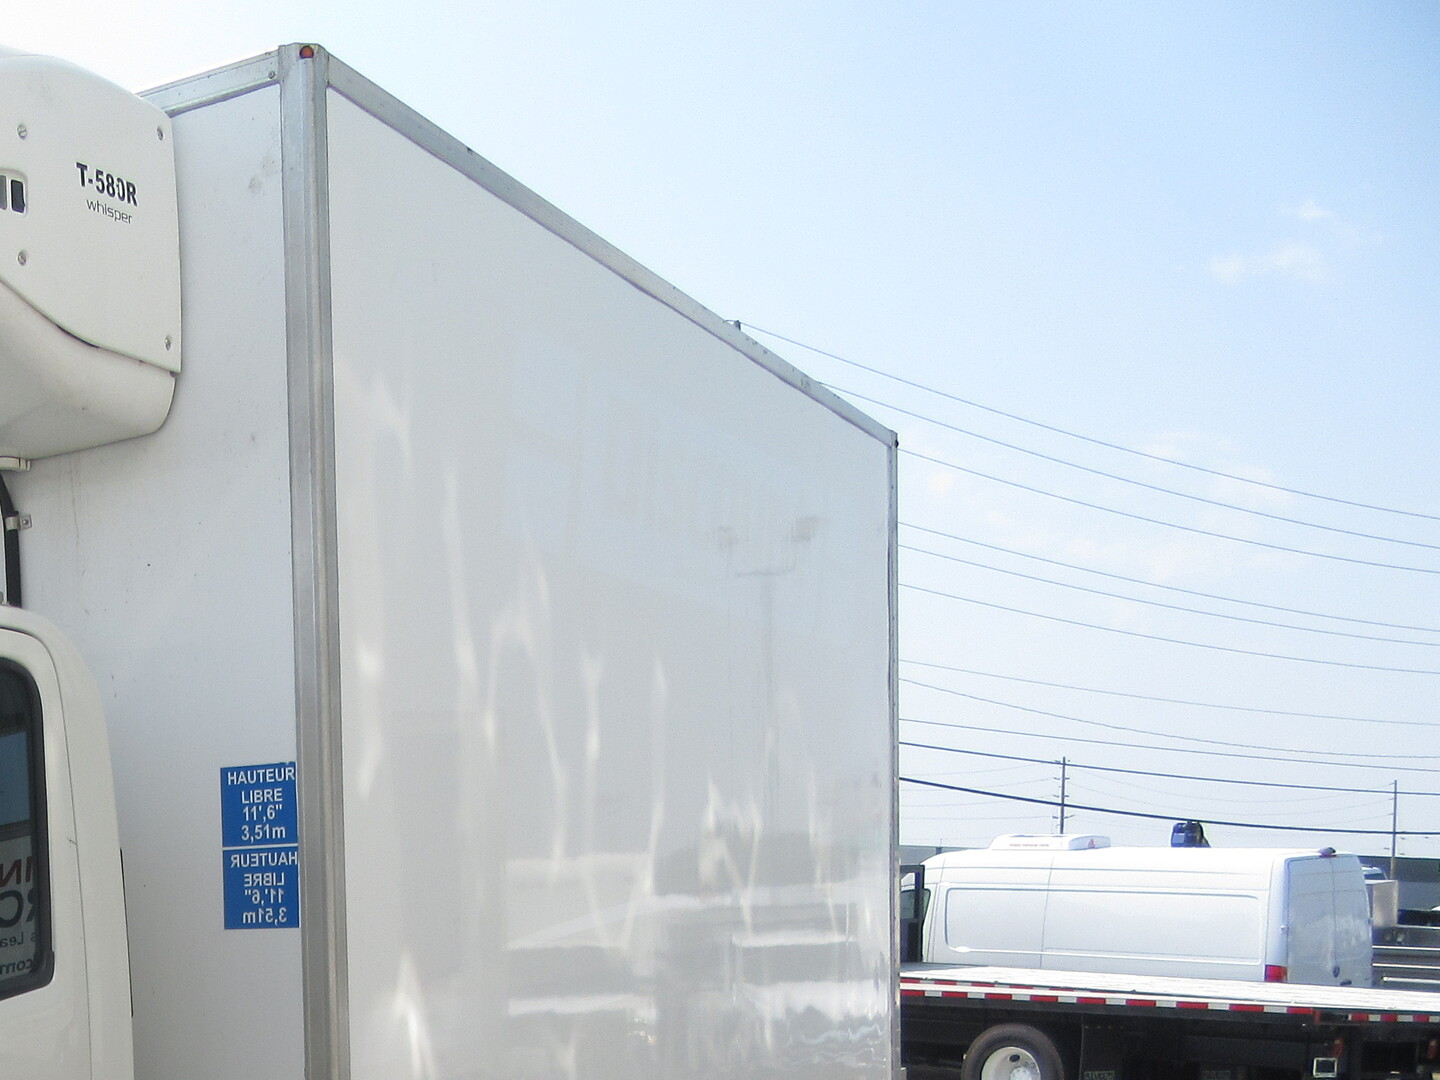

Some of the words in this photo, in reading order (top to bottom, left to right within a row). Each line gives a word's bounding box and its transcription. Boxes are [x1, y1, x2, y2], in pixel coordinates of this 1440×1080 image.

[75, 161, 138, 207] T-580R
[86, 199, 133, 224] whisper
[227, 766, 295, 786] HAUTEUR
[241, 788, 283, 804] LIBRE
[241, 824, 286, 843] 3,51m
